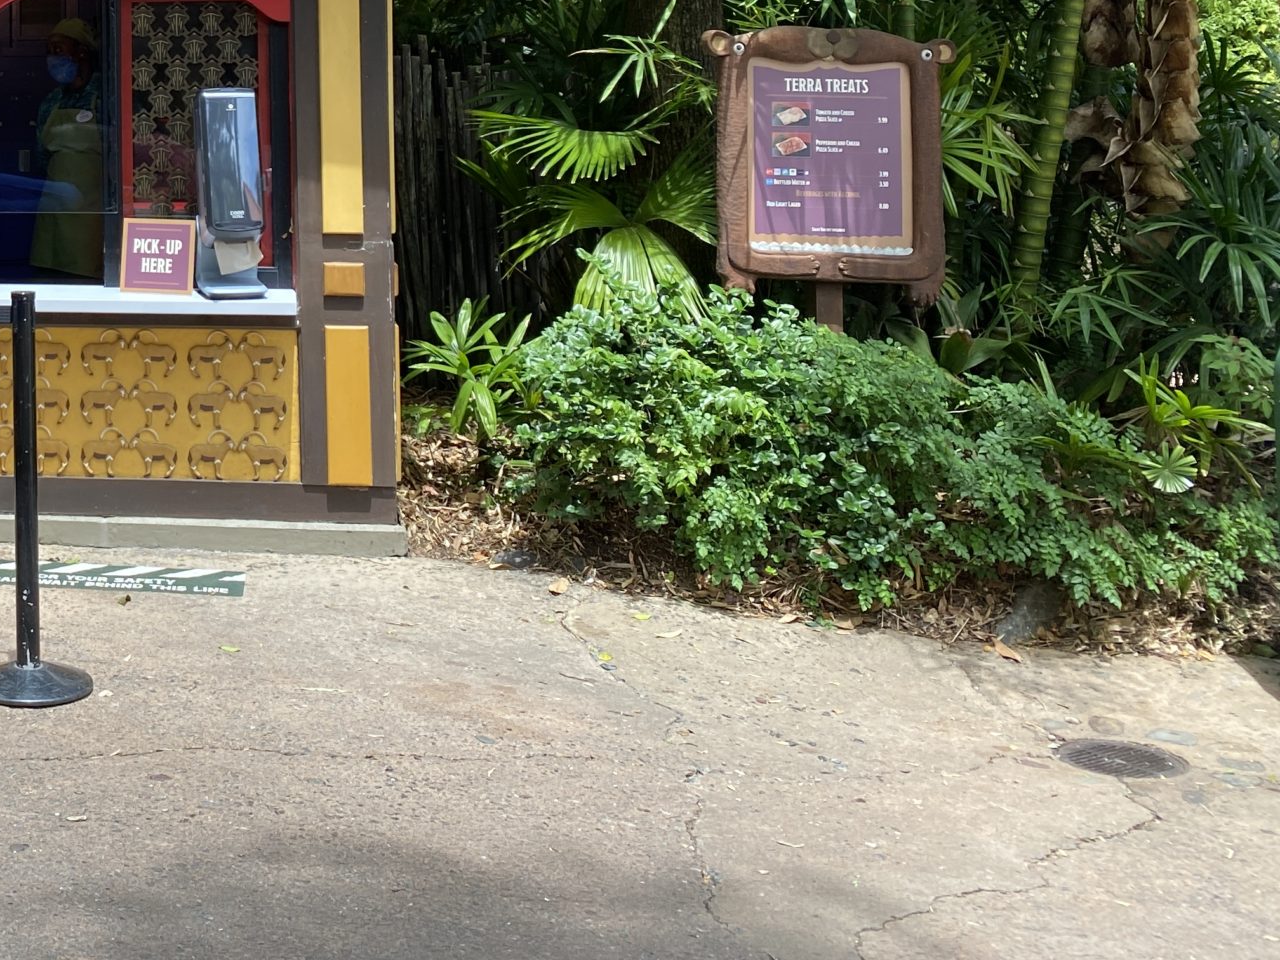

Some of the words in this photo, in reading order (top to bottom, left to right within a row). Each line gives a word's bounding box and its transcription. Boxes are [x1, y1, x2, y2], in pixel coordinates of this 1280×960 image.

[784, 77, 822, 93] TERRA
[825, 78, 869, 94] TREATS
[133, 238, 183, 255] PICK-UP
[140, 257, 173, 274] HERE
[84, 581, 144, 589] BEHIND
[149, 584, 187, 592] THIS
[193, 586, 229, 594] LINE
[113, 577, 176, 586] SAFETY
